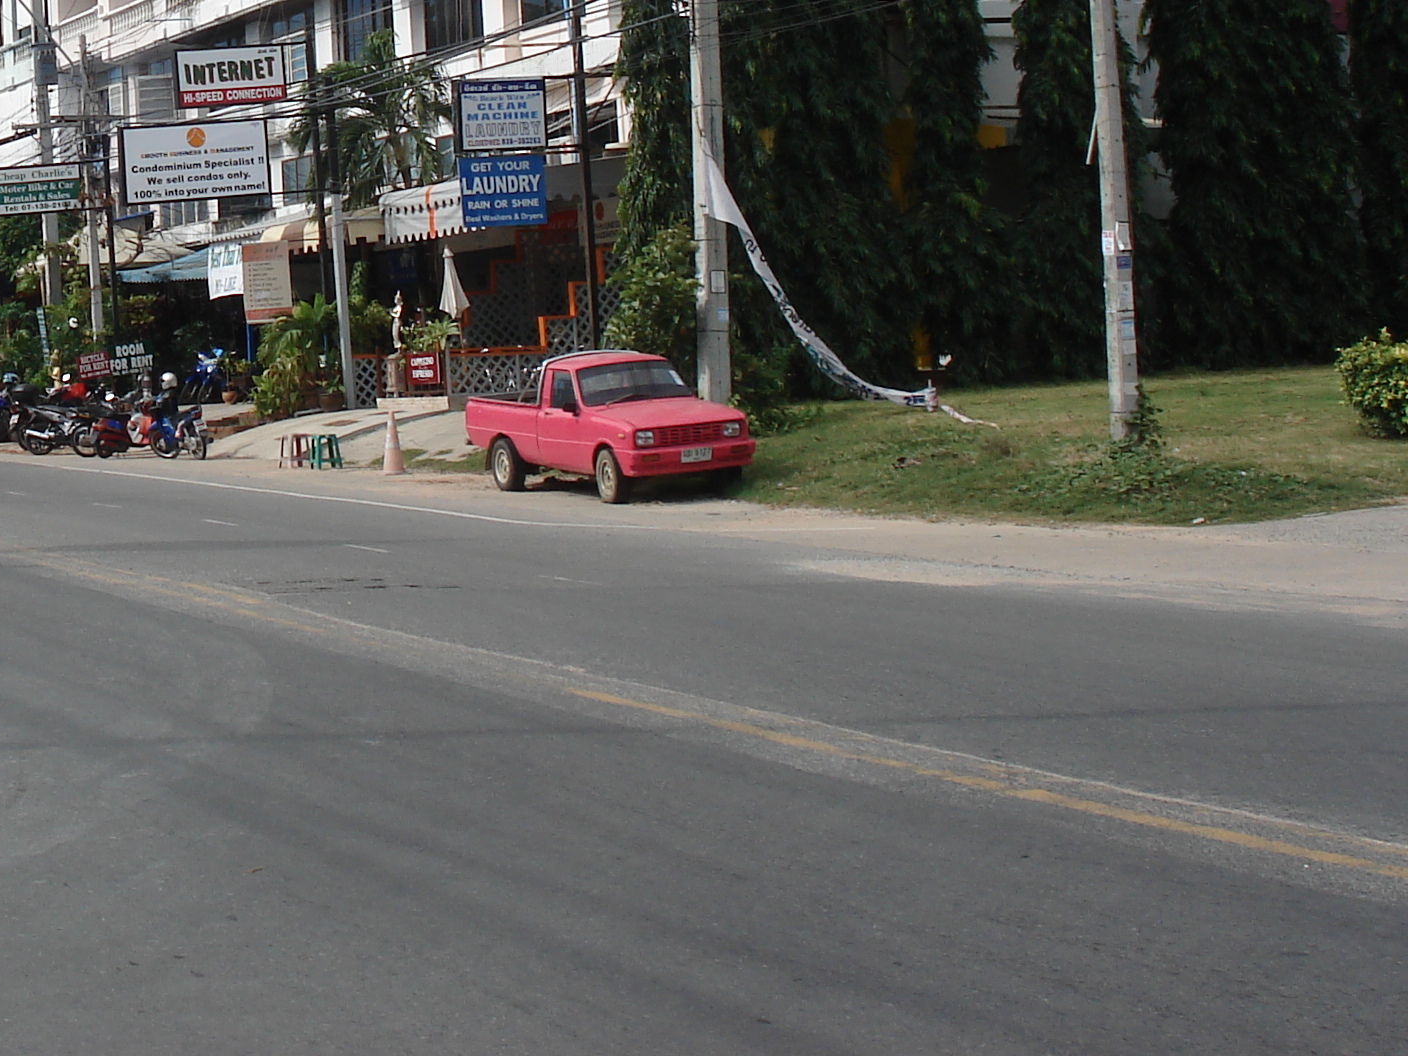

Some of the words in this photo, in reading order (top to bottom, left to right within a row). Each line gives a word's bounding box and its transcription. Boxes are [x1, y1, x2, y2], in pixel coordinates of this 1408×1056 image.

[184, 56, 275, 86] INTERNET
[183, 90, 224, 103] HI-SPEED
[226, 87, 282, 100] CONNECTION
[477, 101, 527, 111] CLEAN
[466, 111, 539, 121] MACHINE
[465, 121, 541, 138] LAUNDRY
[131, 160, 201, 174] Condominium
[204, 156, 254, 170] Specialist
[470, 162, 492, 173] GET
[497, 160, 530, 171] YOUR
[31, 167, 72, 179] Charlie's
[147, 177, 163, 186] We
[166, 174, 184, 184] sell
[187, 172, 225, 183] condos
[134, 189, 162, 199] 100%
[164, 188, 185, 197] into
[186, 186, 208, 197] your
[211, 185, 235, 194] own
[235, 181, 265, 192] name!
[461, 174, 540, 195] LAUNDRY
[3, 193, 37, 203] Rentals
[47, 191, 70, 200] Sales
[467, 200, 491, 210] RAIN
[494, 199, 508, 209] OR
[511, 198, 539, 208] SHINE
[115, 343, 145, 357] ROOM
[93, 361, 109, 371] RENT
[110, 358, 128, 371] FOR
[130, 354, 153, 369] RENT
